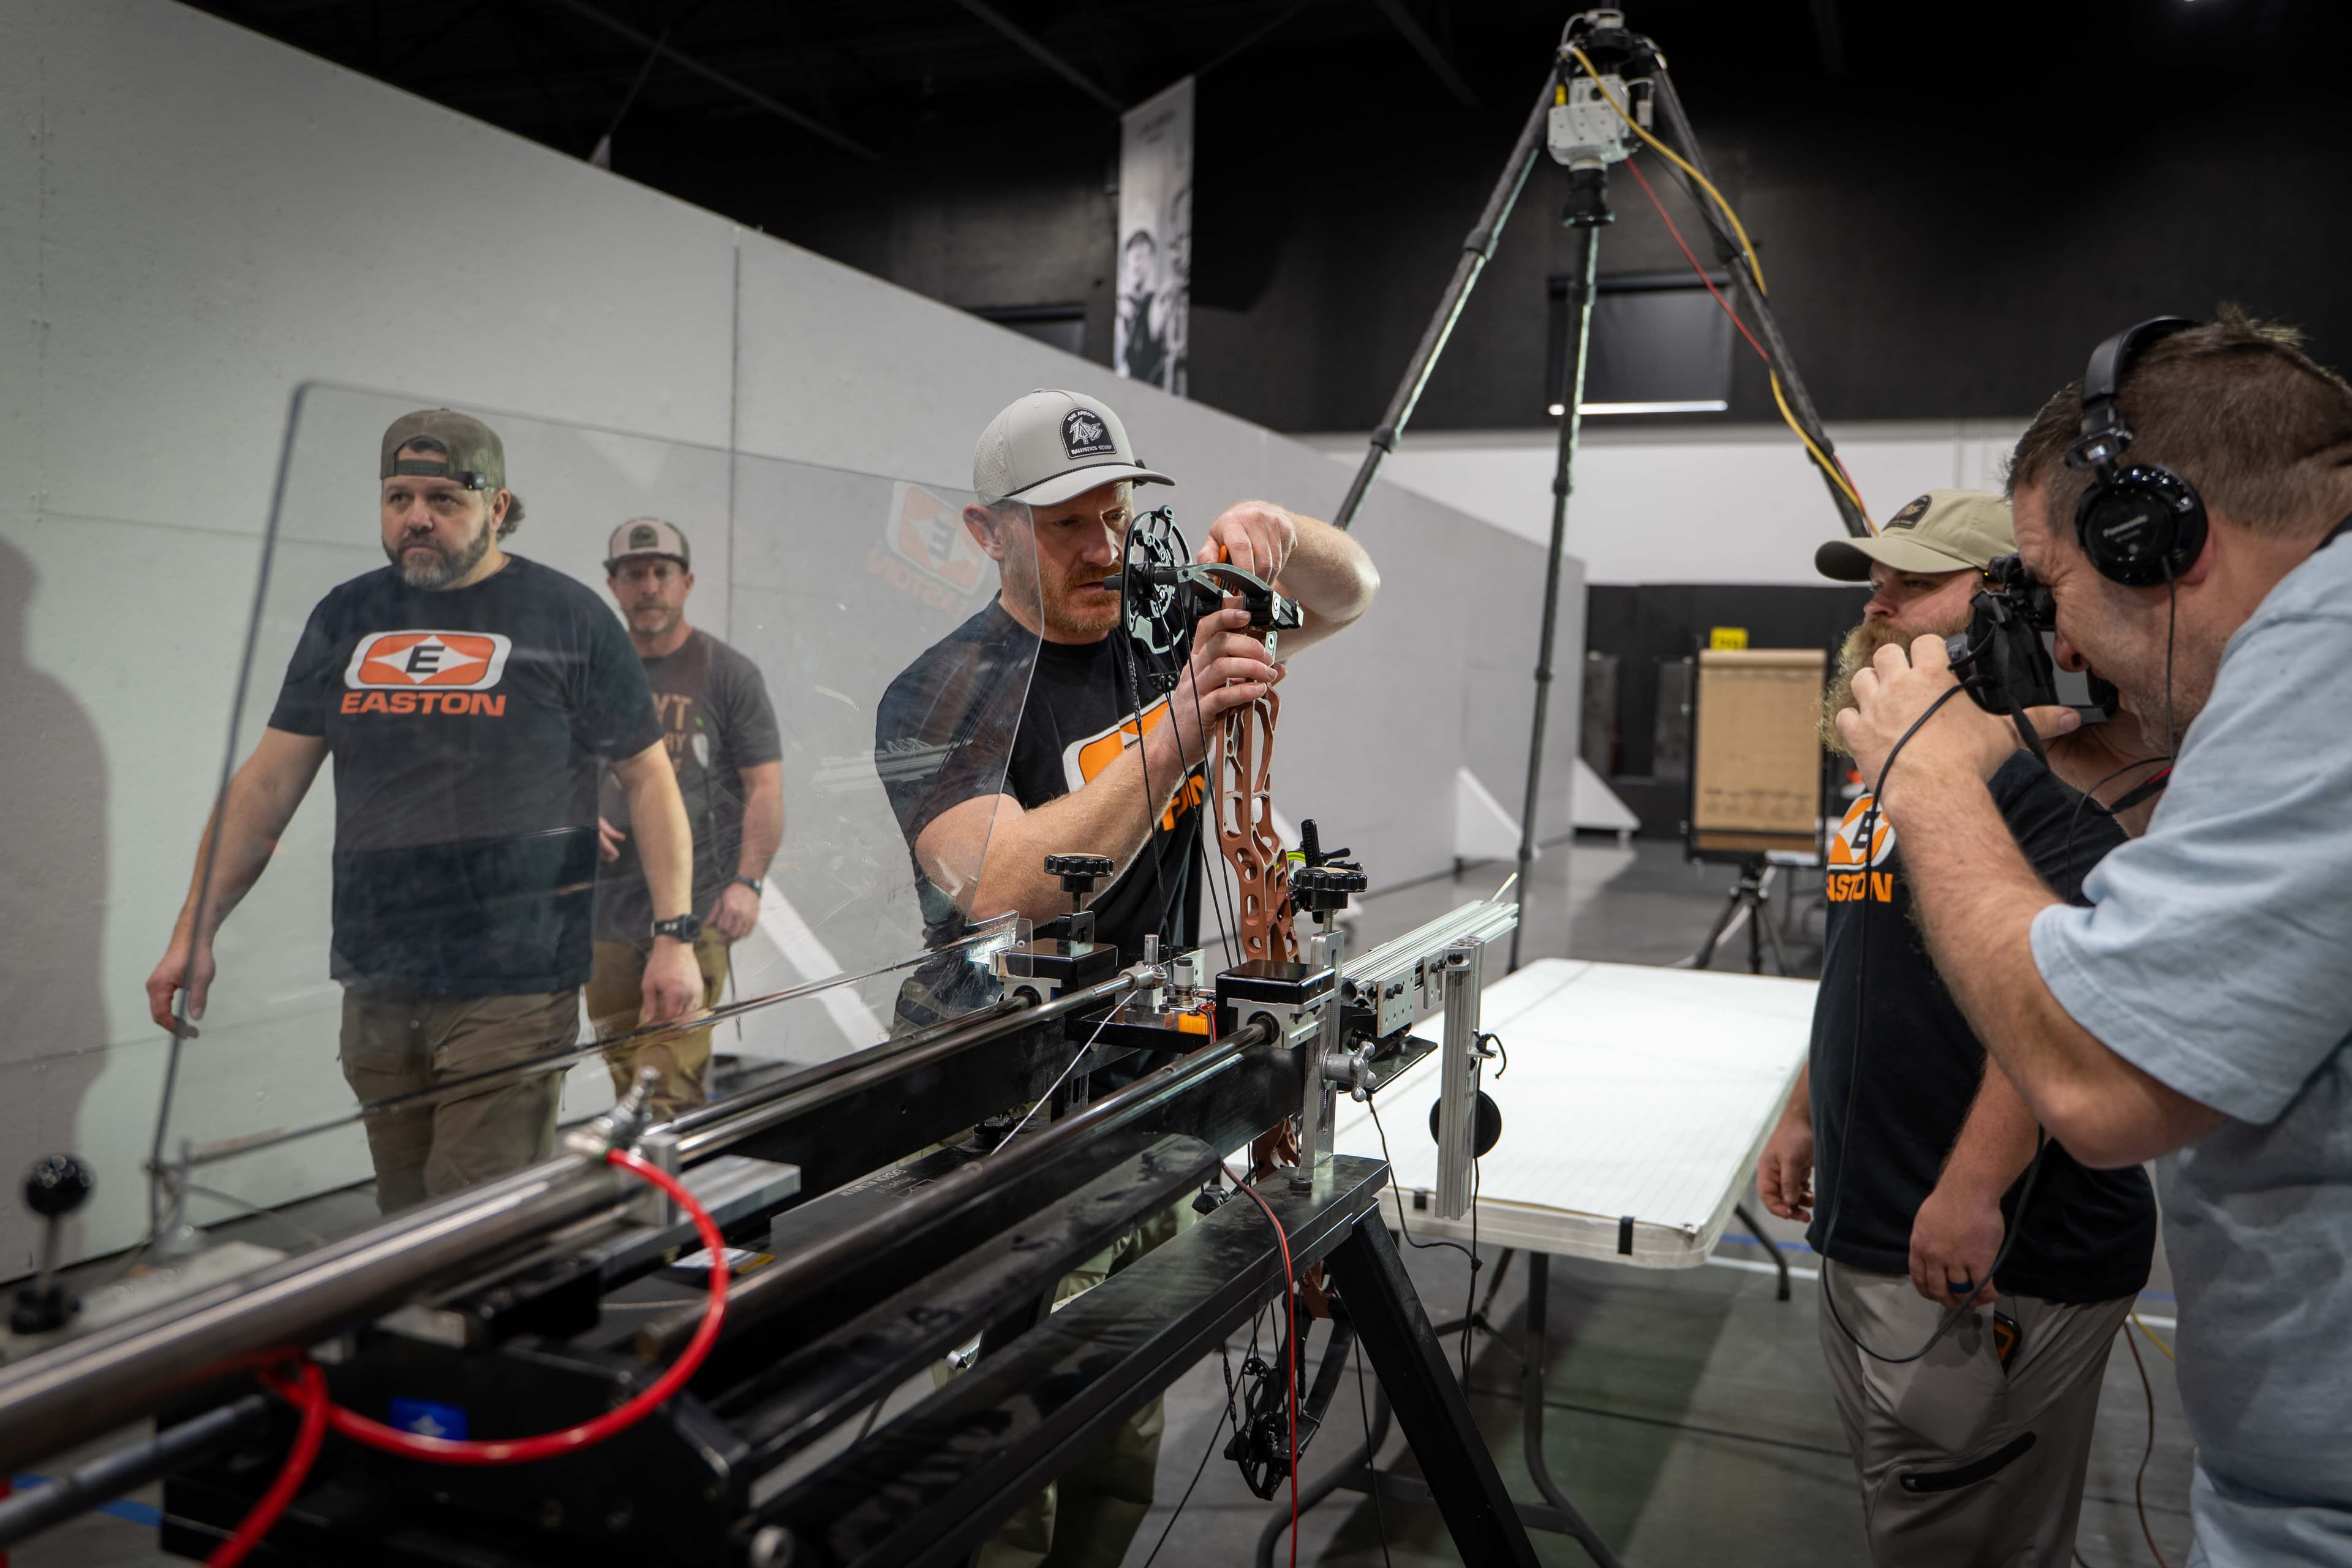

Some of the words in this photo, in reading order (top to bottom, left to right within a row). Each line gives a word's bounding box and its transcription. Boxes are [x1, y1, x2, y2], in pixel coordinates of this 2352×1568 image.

[1068, 413, 1077, 422] THE
[1071, 445, 1098, 454] BALLISTICS
[405, 646, 446, 673] E
[340, 691, 507, 717] EASTON
[651, 692, 693, 731] YT
[1850, 810, 1882, 849] E
[1826, 871, 1894, 903] ASTON
